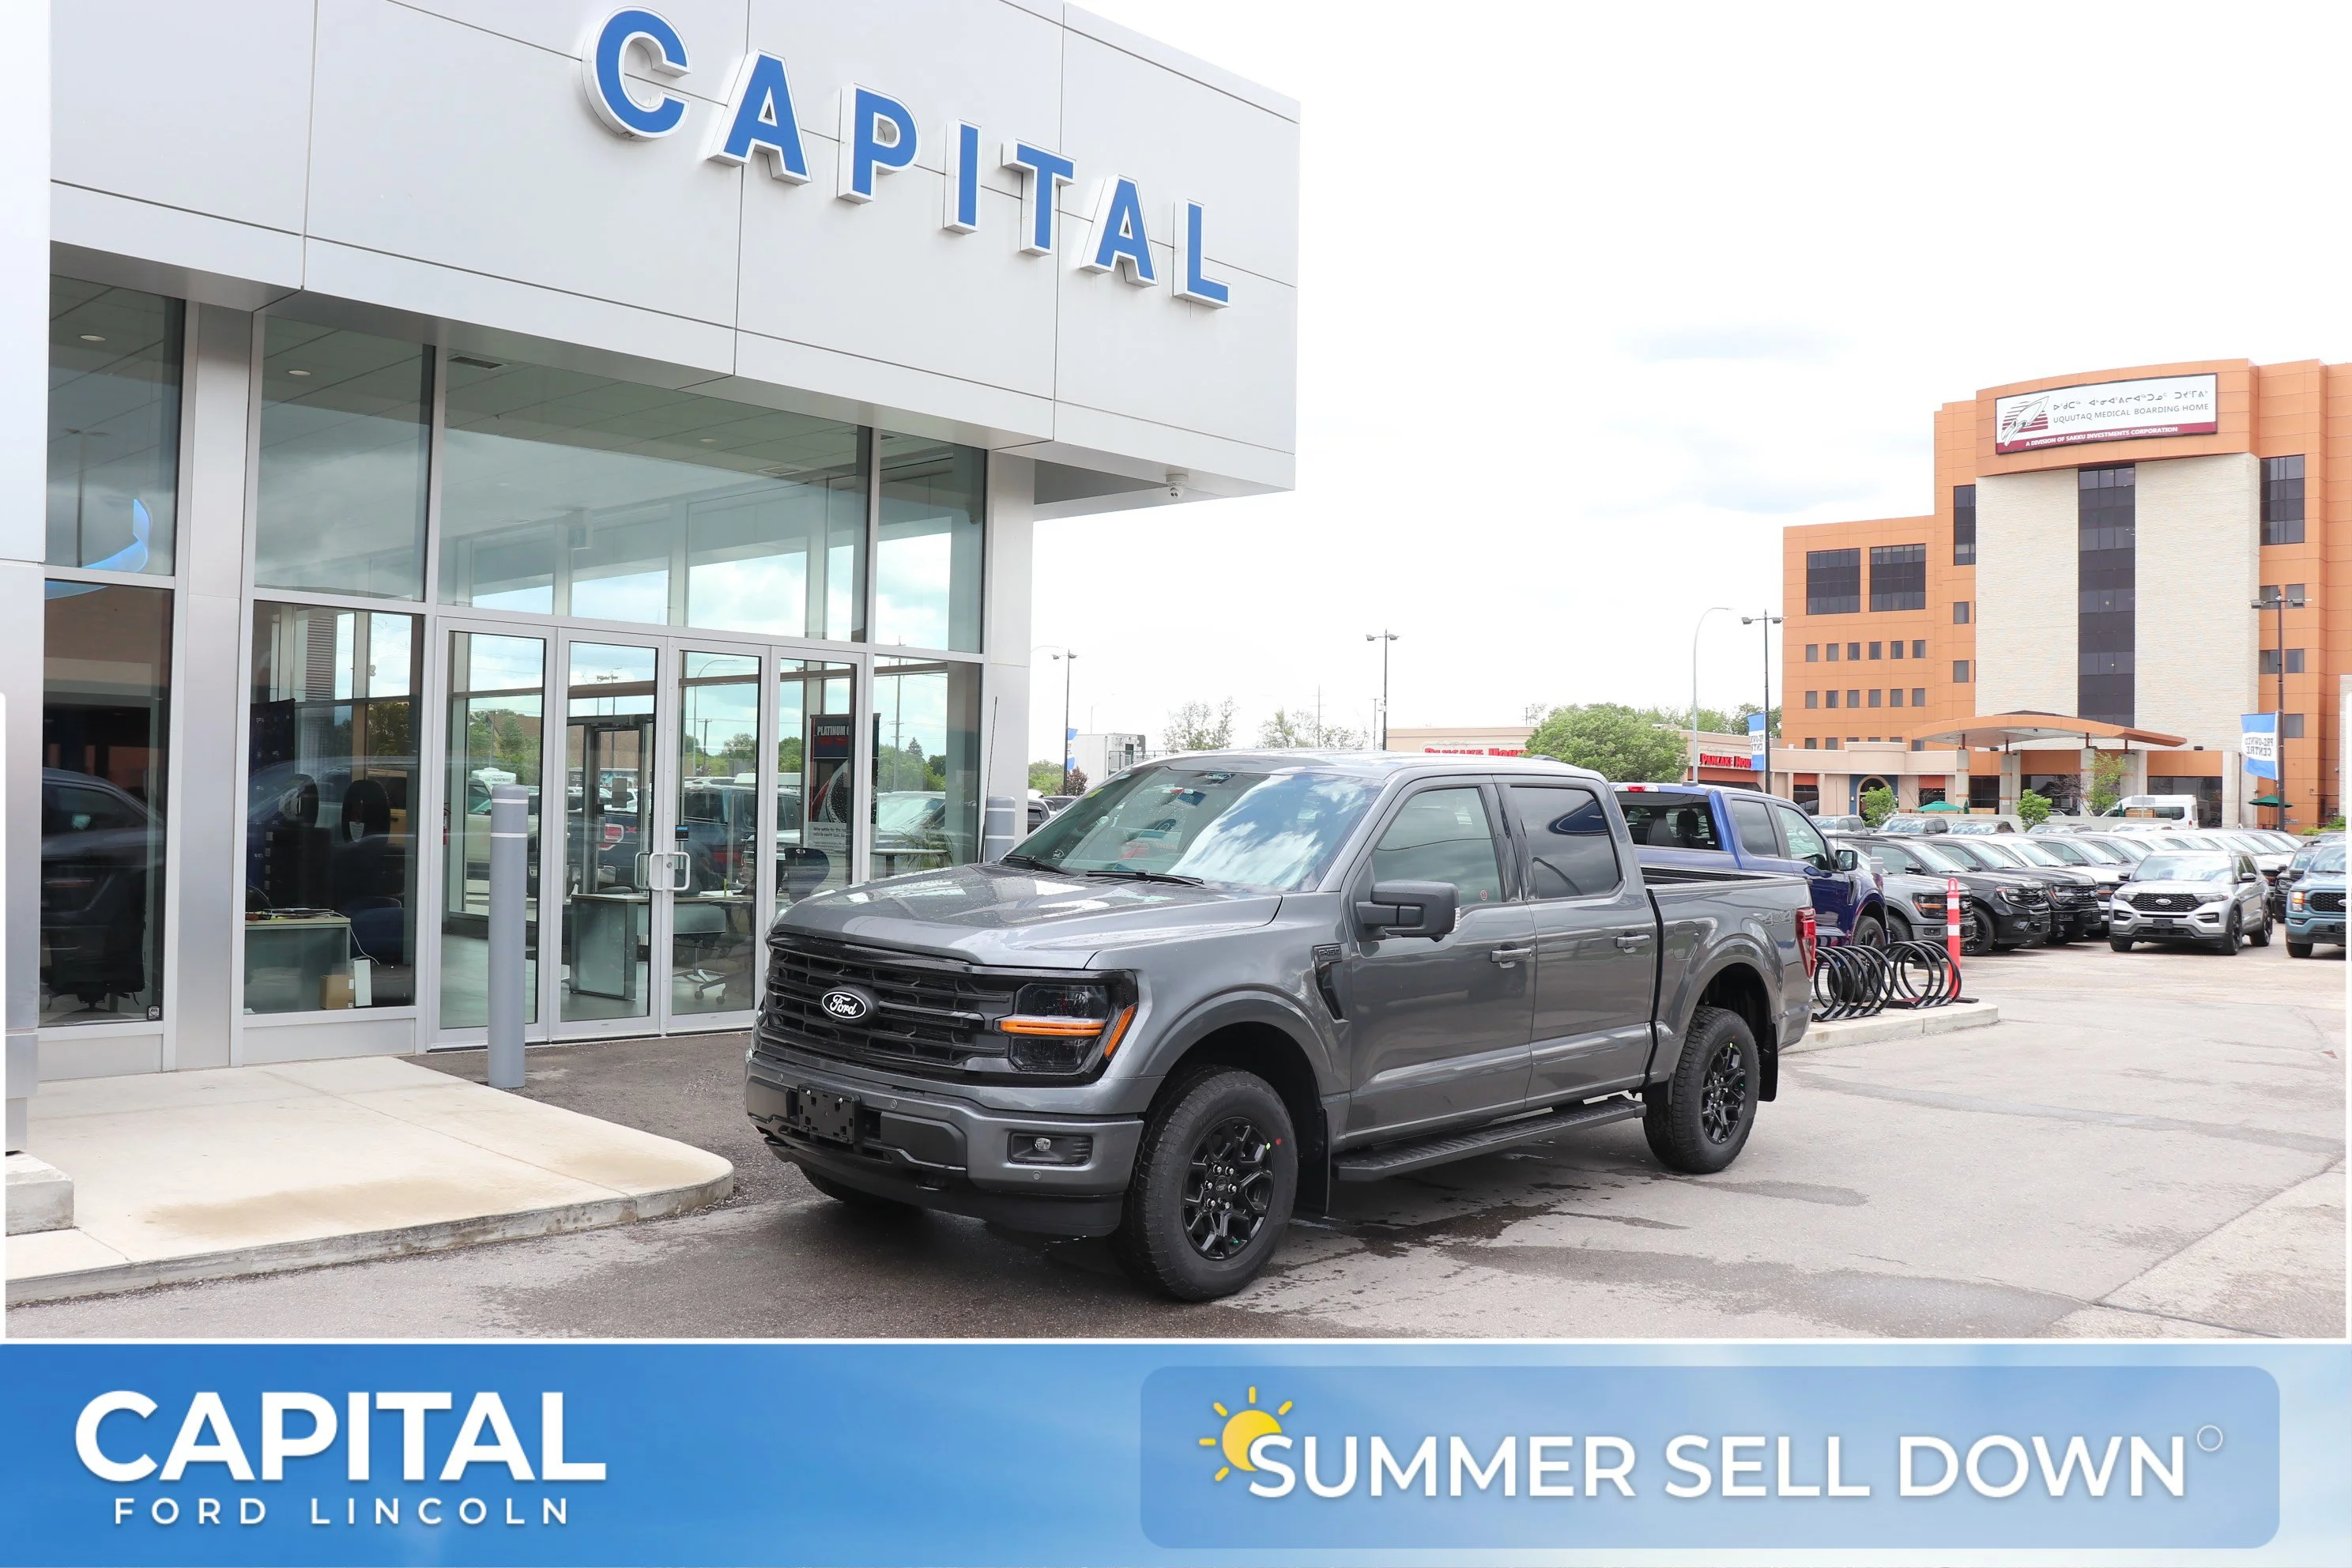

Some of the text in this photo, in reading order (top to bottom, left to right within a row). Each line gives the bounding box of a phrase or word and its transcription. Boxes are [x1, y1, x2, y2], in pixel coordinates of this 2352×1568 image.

[585, 6, 1231, 309] CAPITAL
[2053, 413, 2093, 424] UQUUTAQ
[2094, 409, 2131, 419] MEDICAL
[2134, 405, 2180, 415] BOARDING
[2030, 437, 2056, 446] DIVISION
[2086, 429, 2130, 439] INVESTMENTS
[2130, 426, 2178, 436] CORPORATION
[816, 726, 846, 736] PLATINUM
[1734, 756, 1752, 768] HOU
[829, 993, 858, 1016] Ford
